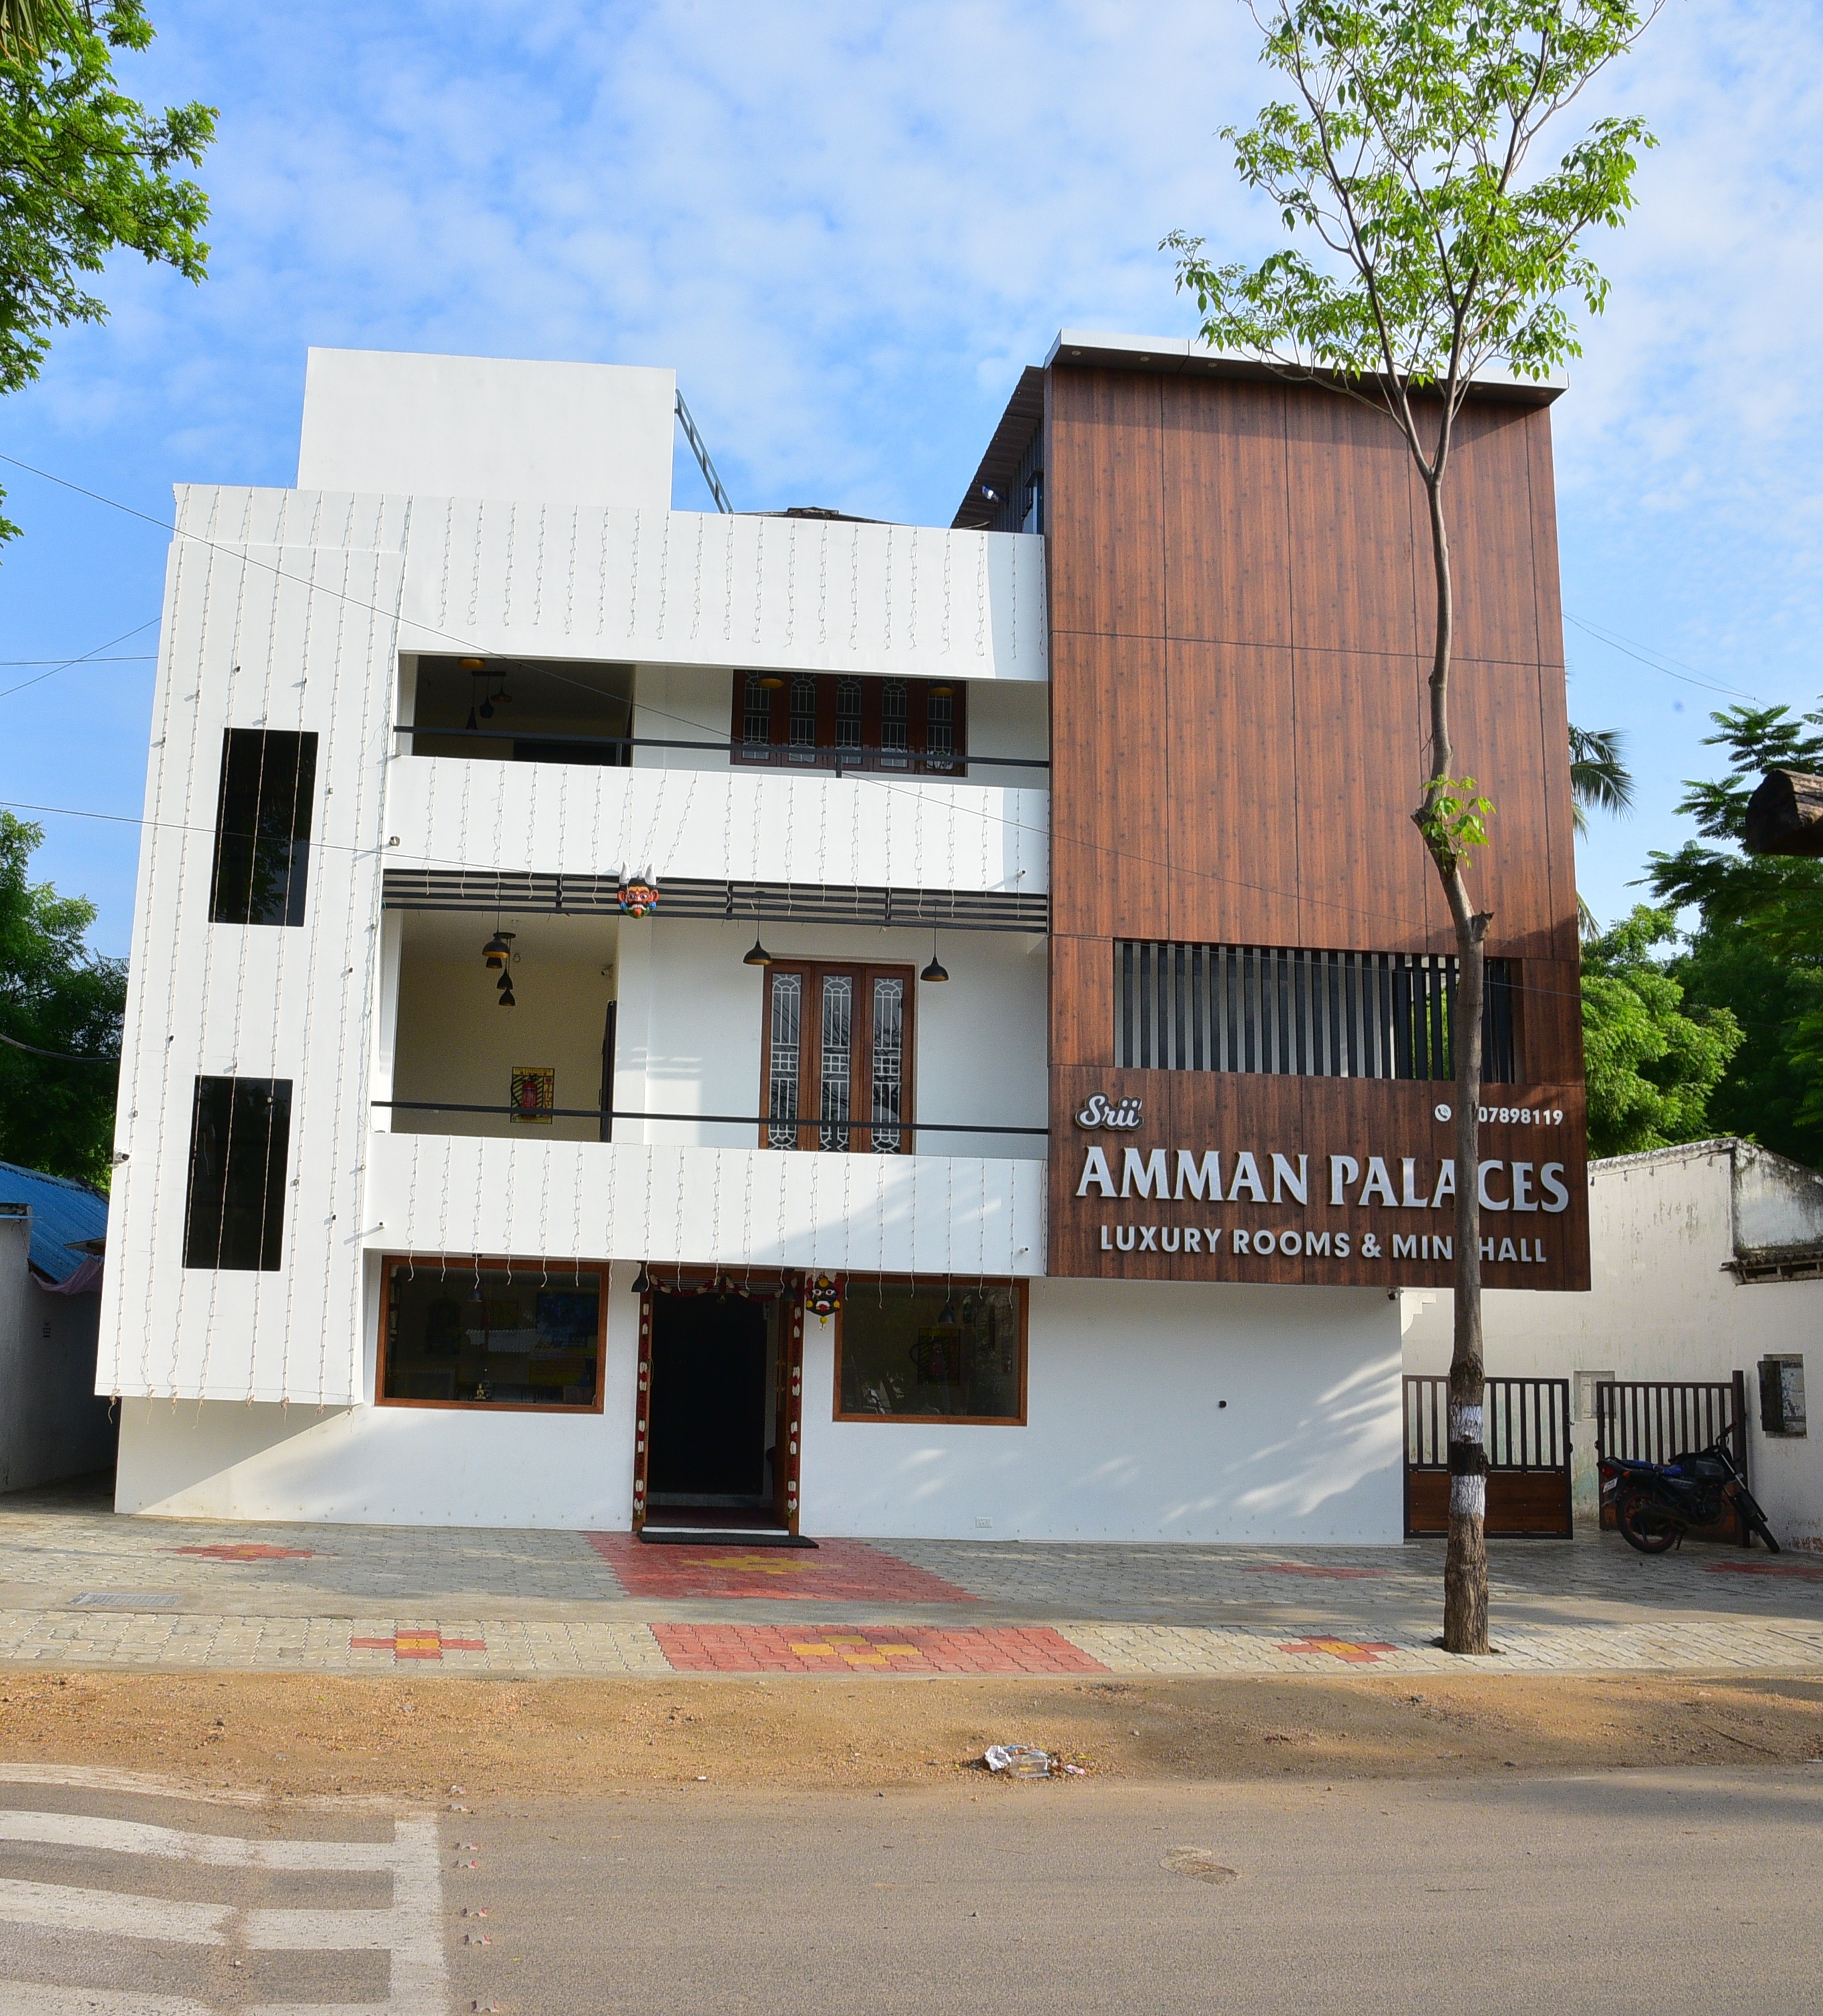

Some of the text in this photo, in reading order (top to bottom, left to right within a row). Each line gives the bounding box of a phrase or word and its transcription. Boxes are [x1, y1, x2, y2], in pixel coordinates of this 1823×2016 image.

[1078, 1094, 1143, 1128] Srii
[1478, 1106, 1564, 1126] 07898119
[1075, 1145, 1570, 1212] AMMAN PALACES
[1101, 1224, 1547, 1263] LUXURY ROOMS & MIN HALL
